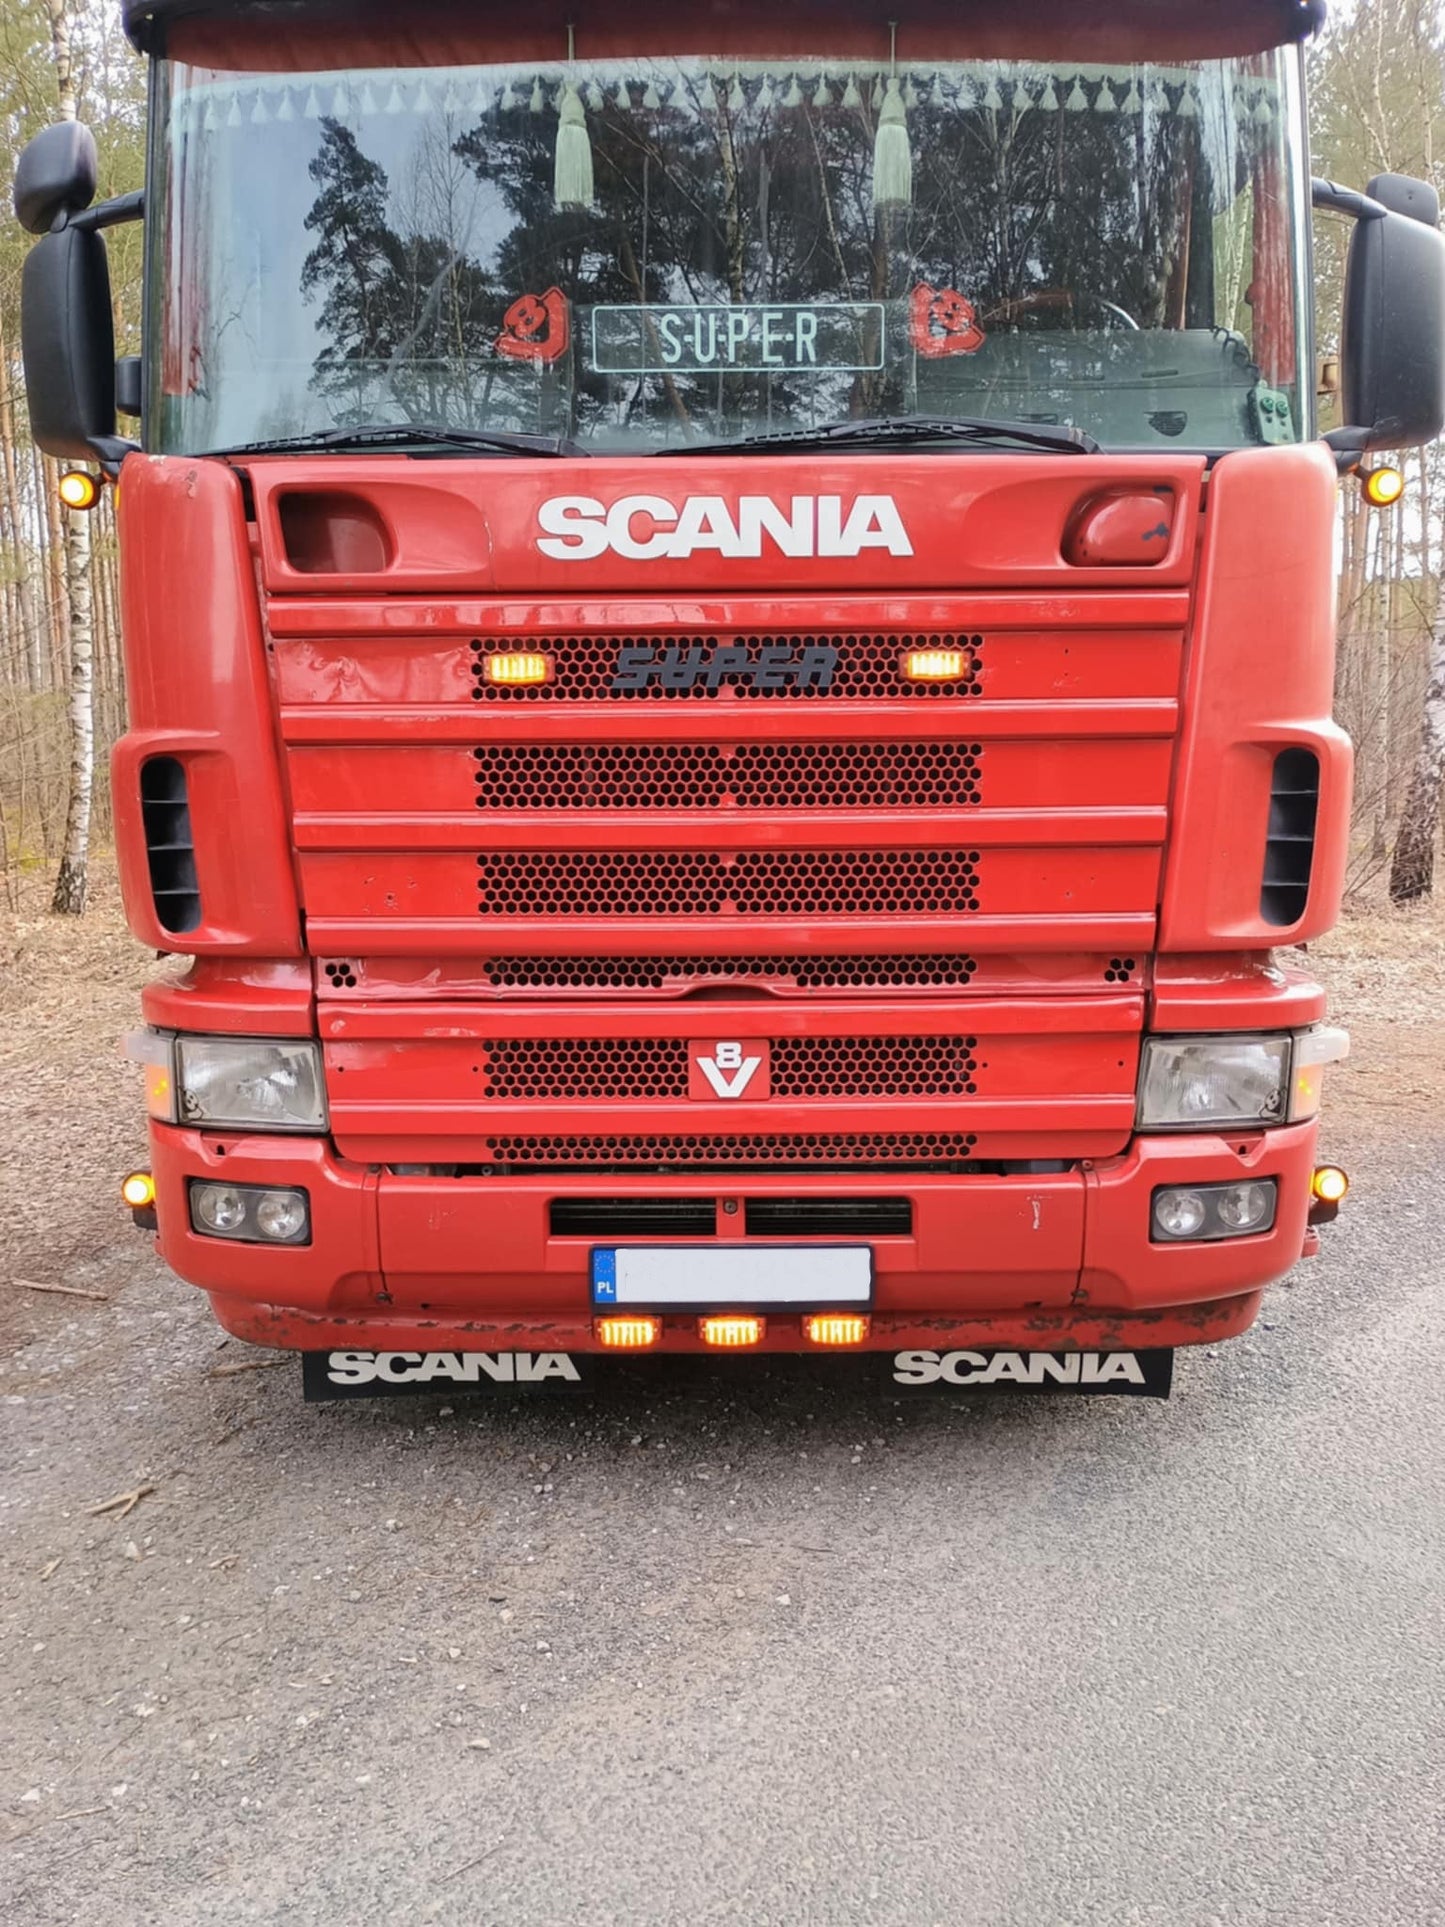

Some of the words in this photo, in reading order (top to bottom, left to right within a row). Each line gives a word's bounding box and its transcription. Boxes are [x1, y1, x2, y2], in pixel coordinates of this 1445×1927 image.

[536, 496, 914, 559] SCANIA
[612, 646, 838, 688] SUPER
[597, 1281, 614, 1294] PL
[327, 1351, 581, 1384] SCANIA
[893, 1350, 1146, 1384] SCANIA
